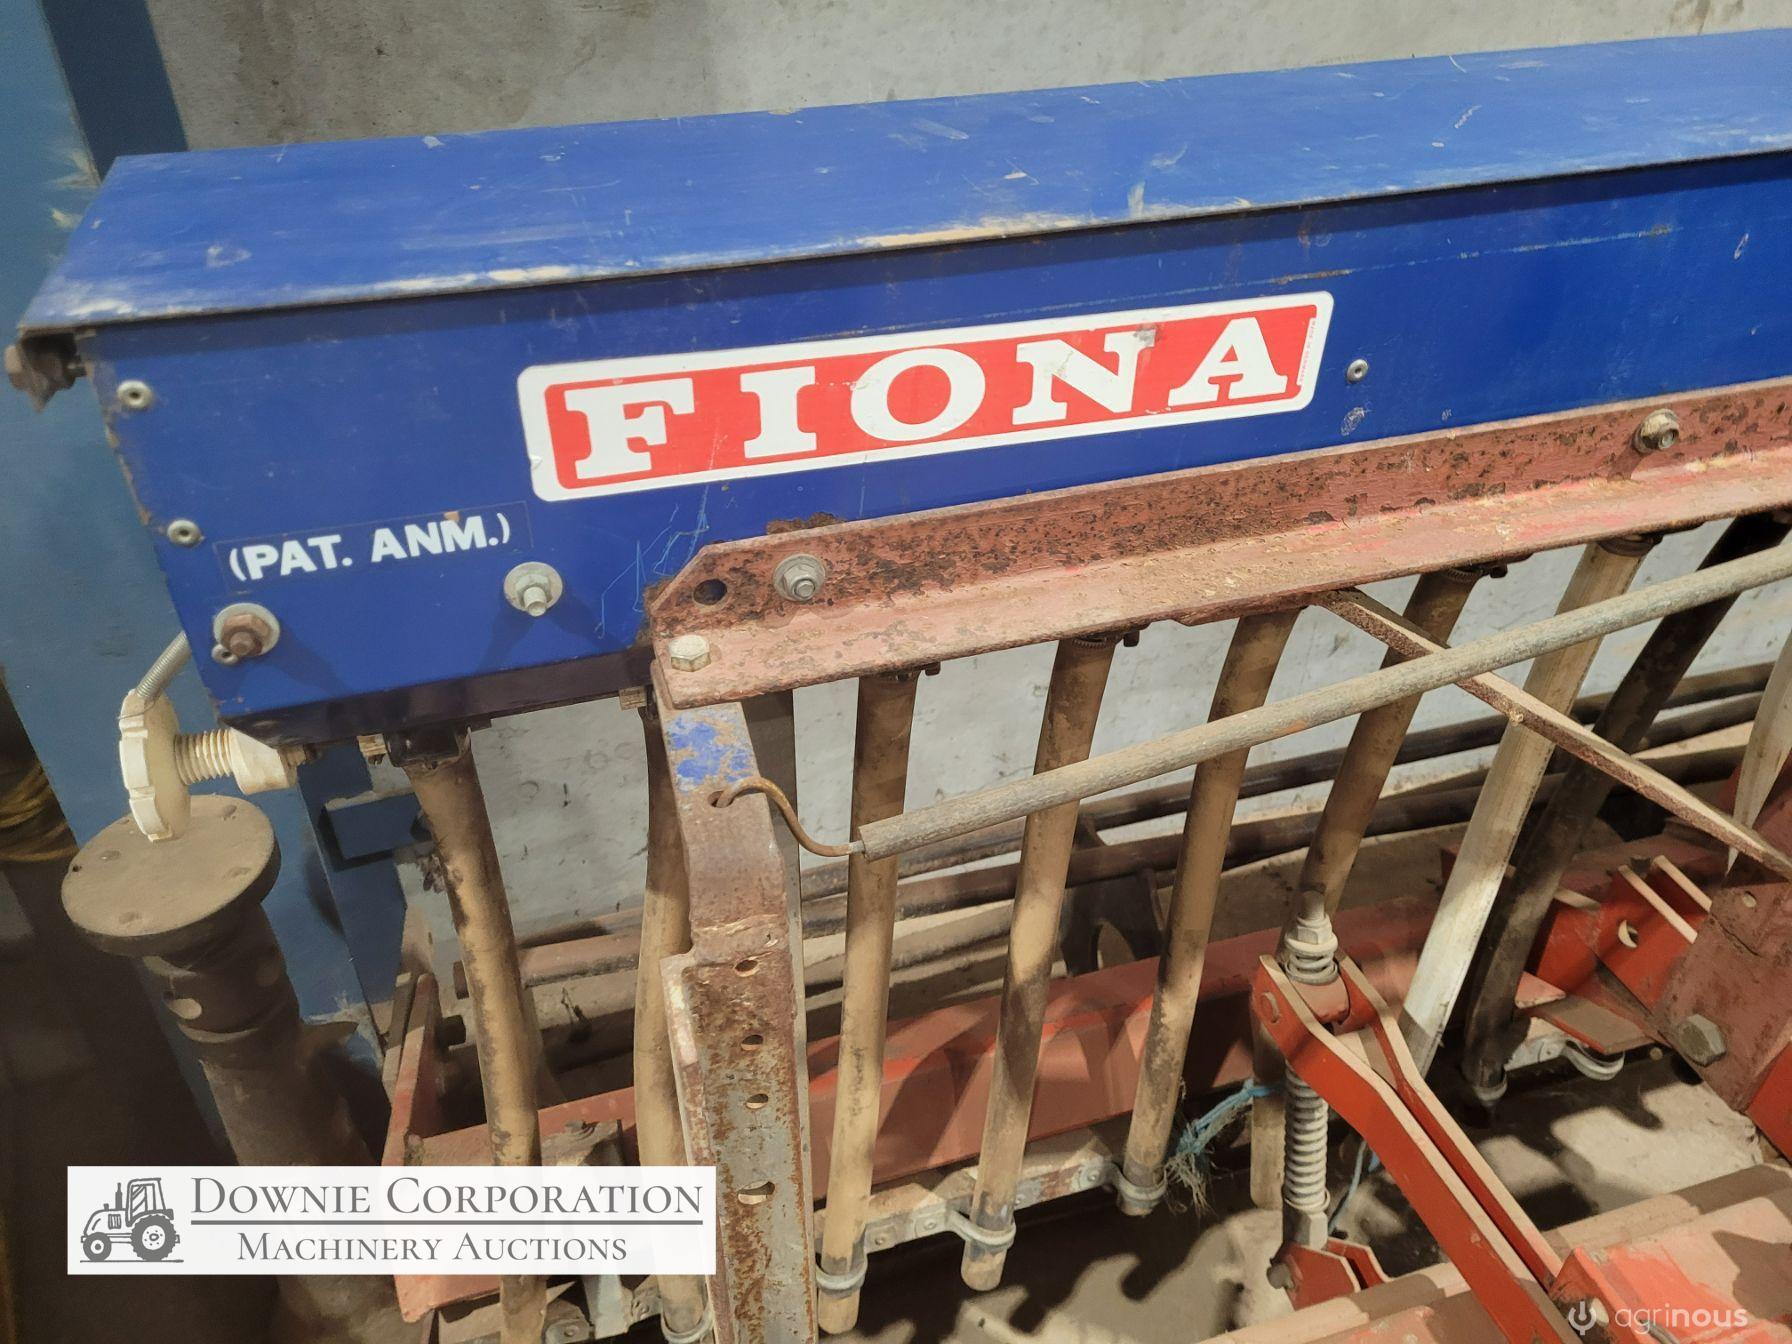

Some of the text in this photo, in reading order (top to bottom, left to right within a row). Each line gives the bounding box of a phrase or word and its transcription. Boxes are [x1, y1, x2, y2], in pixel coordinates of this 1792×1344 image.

[564, 317, 1289, 479] FIONA
[229, 512, 511, 582] (PAT. ANM.)
